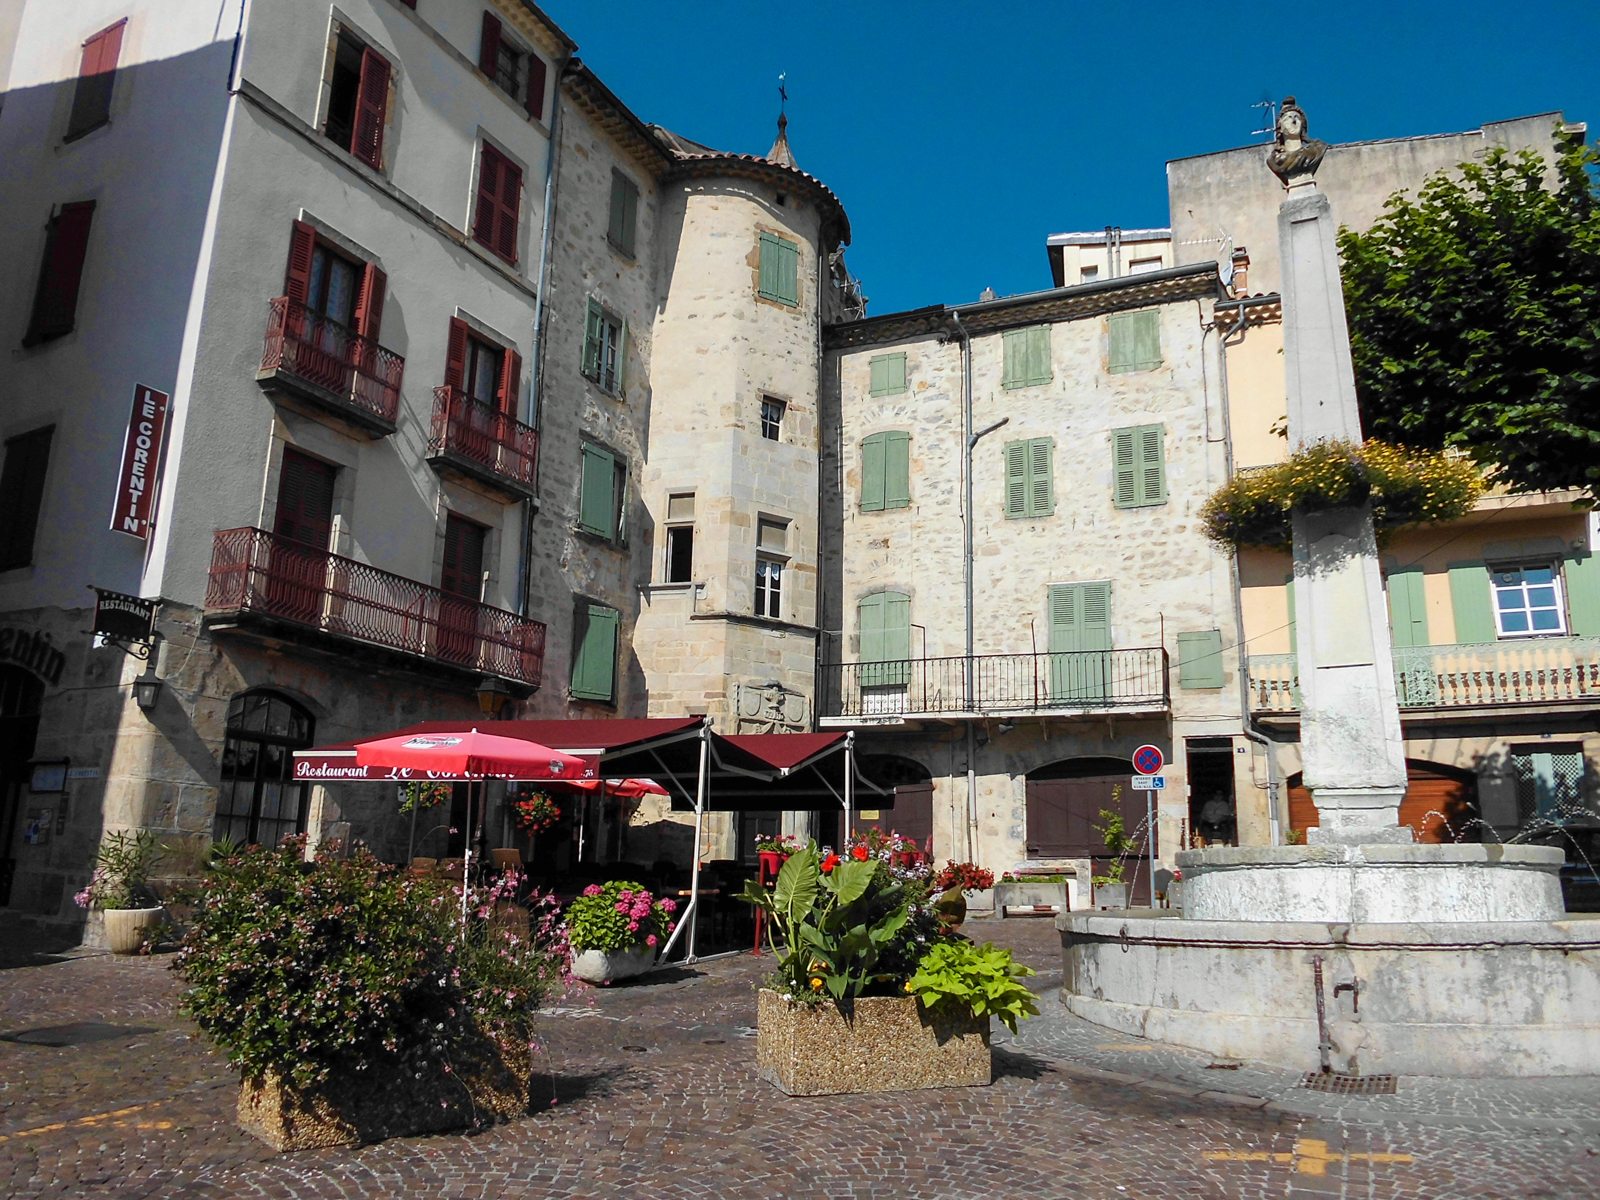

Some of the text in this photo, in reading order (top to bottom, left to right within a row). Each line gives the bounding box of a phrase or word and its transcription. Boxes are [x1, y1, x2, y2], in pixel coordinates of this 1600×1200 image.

[123, 390, 156, 533] LE CORENTIN
[100, 600, 151, 620] RESTAURANT
[297, 761, 369, 777] Restaurant
